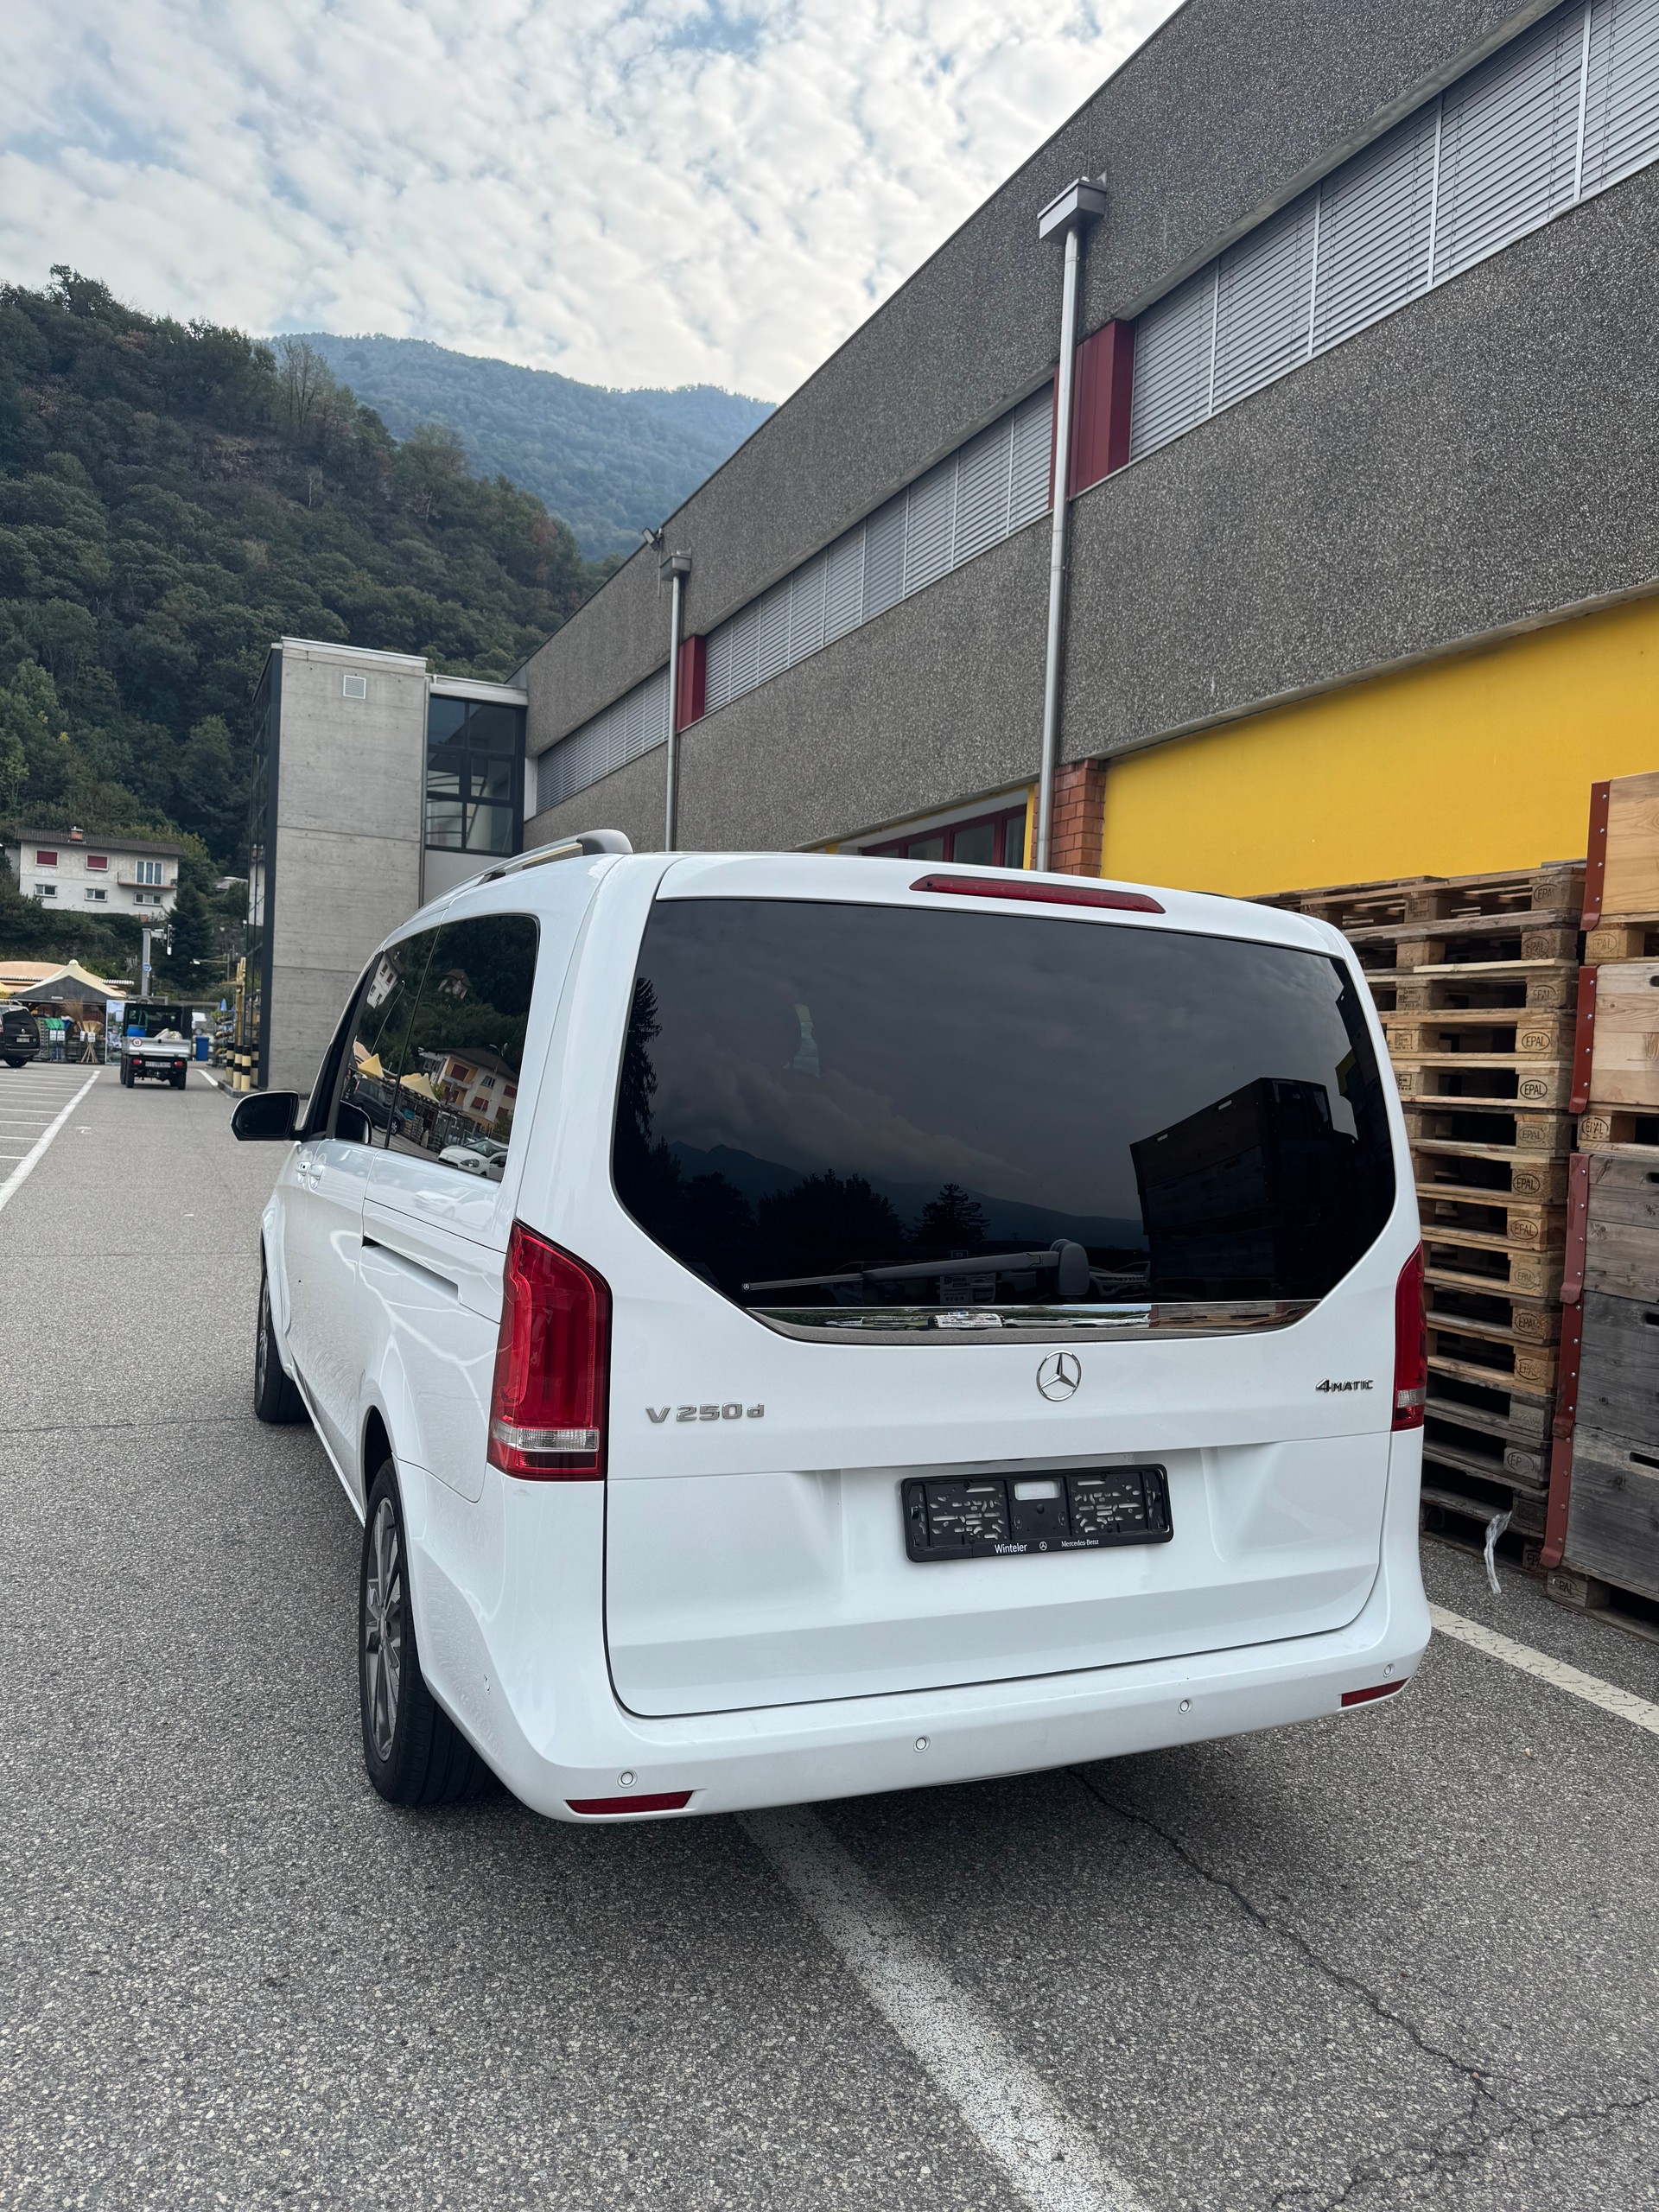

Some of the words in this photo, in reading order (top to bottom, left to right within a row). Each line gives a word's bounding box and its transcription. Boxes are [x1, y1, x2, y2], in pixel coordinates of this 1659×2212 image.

[1526, 1036, 1546, 1047] EPAL
[1524, 1084, 1543, 1096] EPAL
[1585, 1121, 1605, 1135] EPAL
[1522, 1130, 1542, 1141] EPAL
[1516, 1179, 1536, 1191] EPAL
[1514, 1223, 1534, 1236] EPAL
[1517, 1272, 1532, 1282] EPAL
[1316, 1379, 1373, 1392] 4MATIC
[995, 1542, 1027, 1554] Winteler
[1061, 1538, 1099, 1548] Mercedes-Benz
